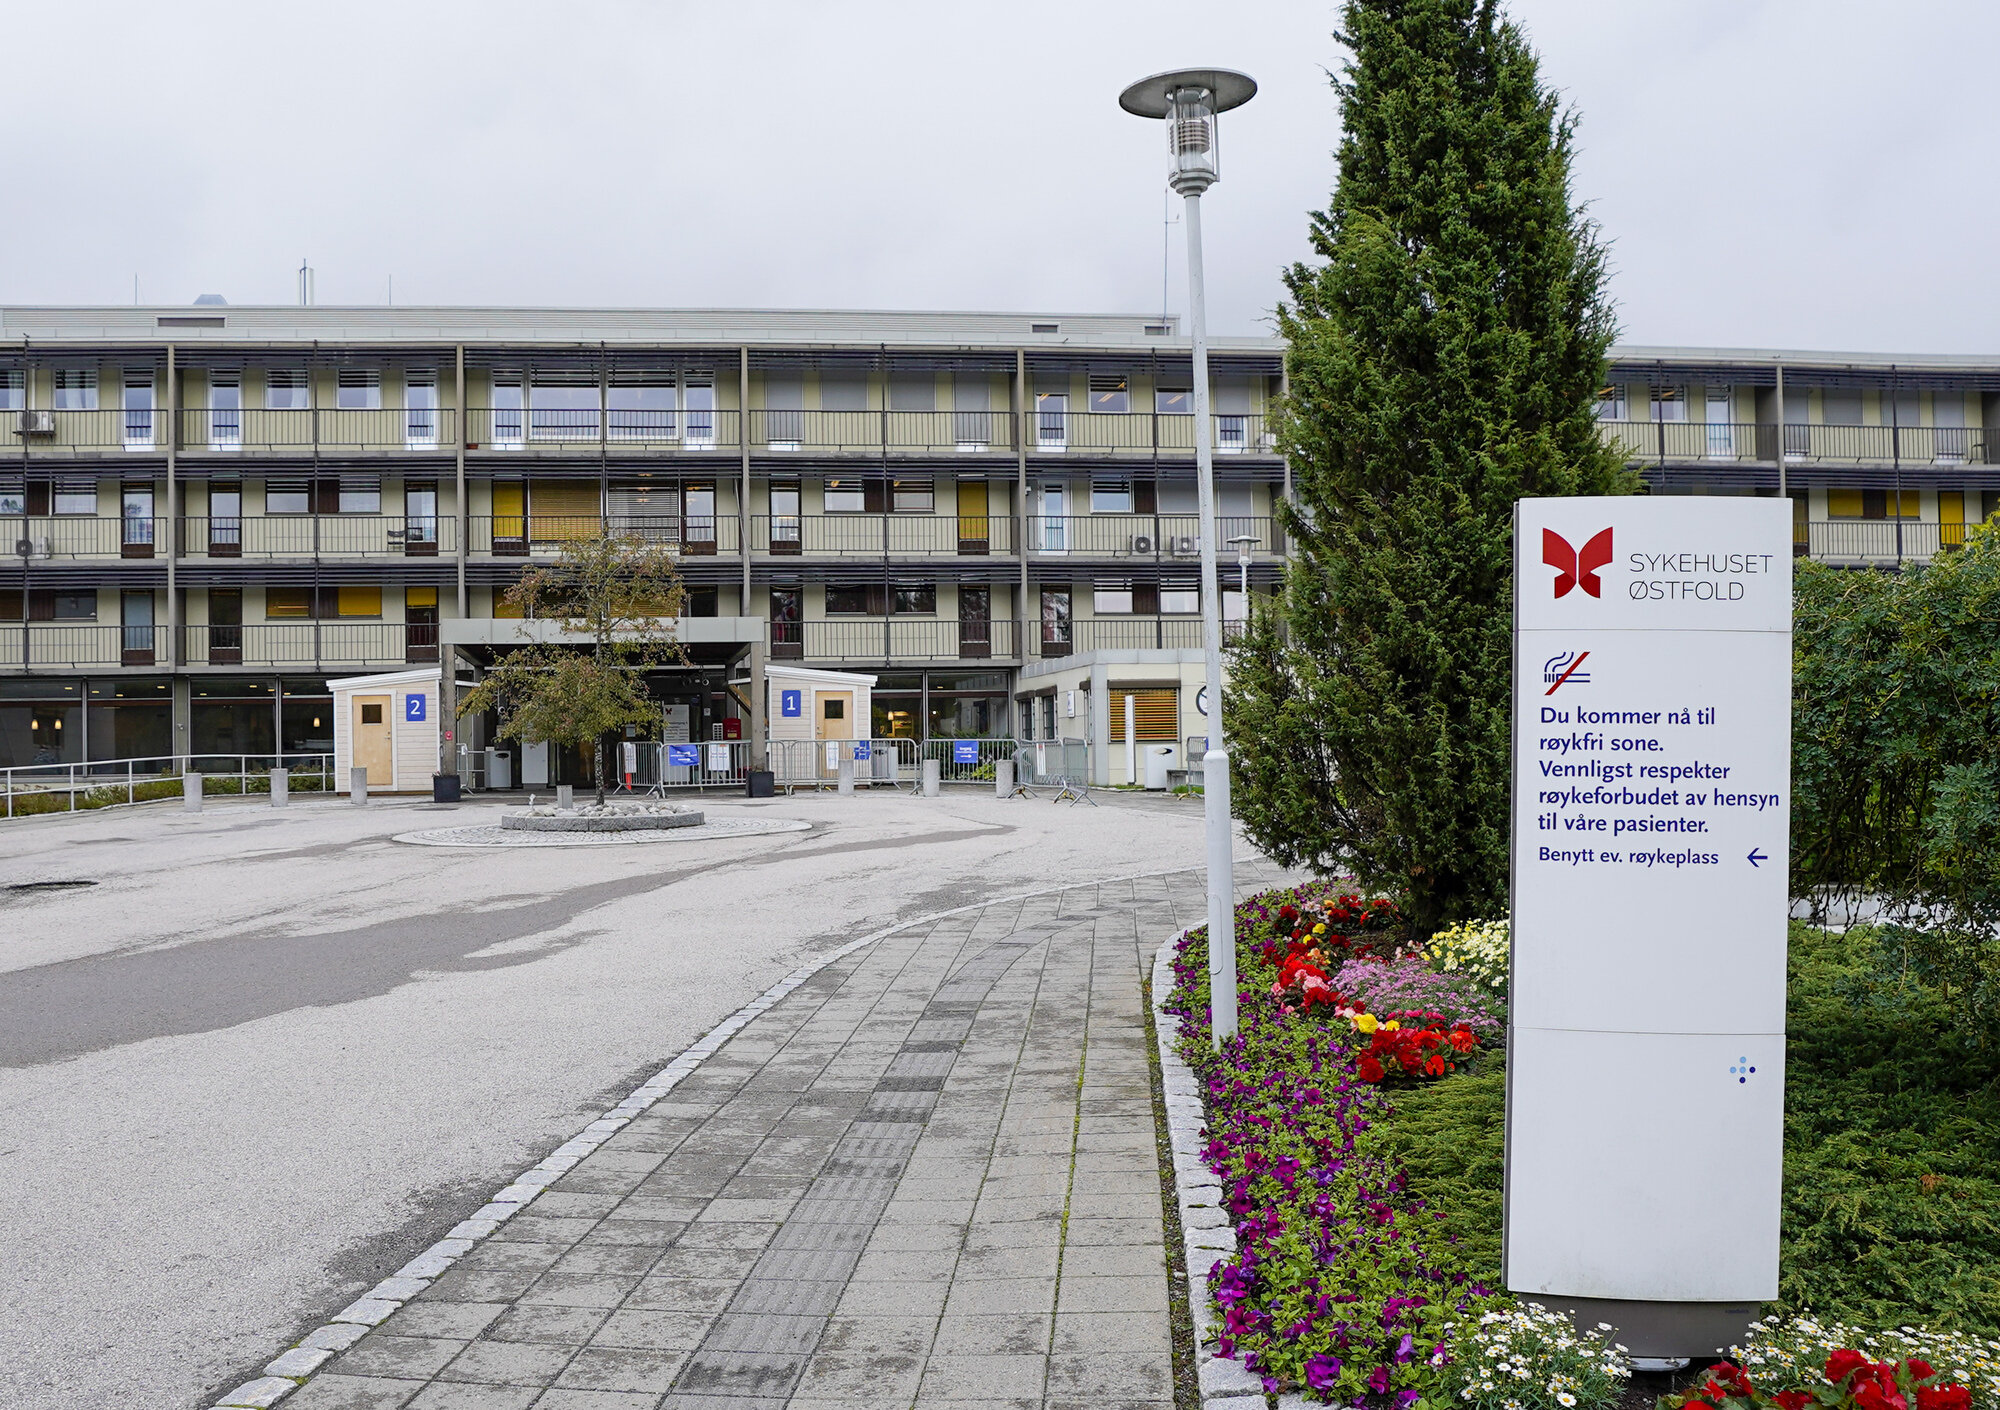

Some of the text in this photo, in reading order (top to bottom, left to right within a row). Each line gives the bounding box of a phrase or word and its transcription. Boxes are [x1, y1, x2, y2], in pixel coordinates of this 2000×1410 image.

[1629, 553, 1774, 574] SYKEHUSET
[1628, 580, 1745, 601] ØSTFOLD
[410, 699, 421, 714] 2
[787, 695, 796, 710] 1
[1540, 706, 1716, 725] Du kommer nå til
[1539, 732, 1664, 755] røykfri sone.
[1539, 759, 1731, 784] Vennligst respekter
[1538, 786, 1780, 812] røykeforbudet av hensyn
[1537, 812, 1709, 837] til våre pasienter.
[1539, 846, 1720, 868] Benytt ev. røykeplass
